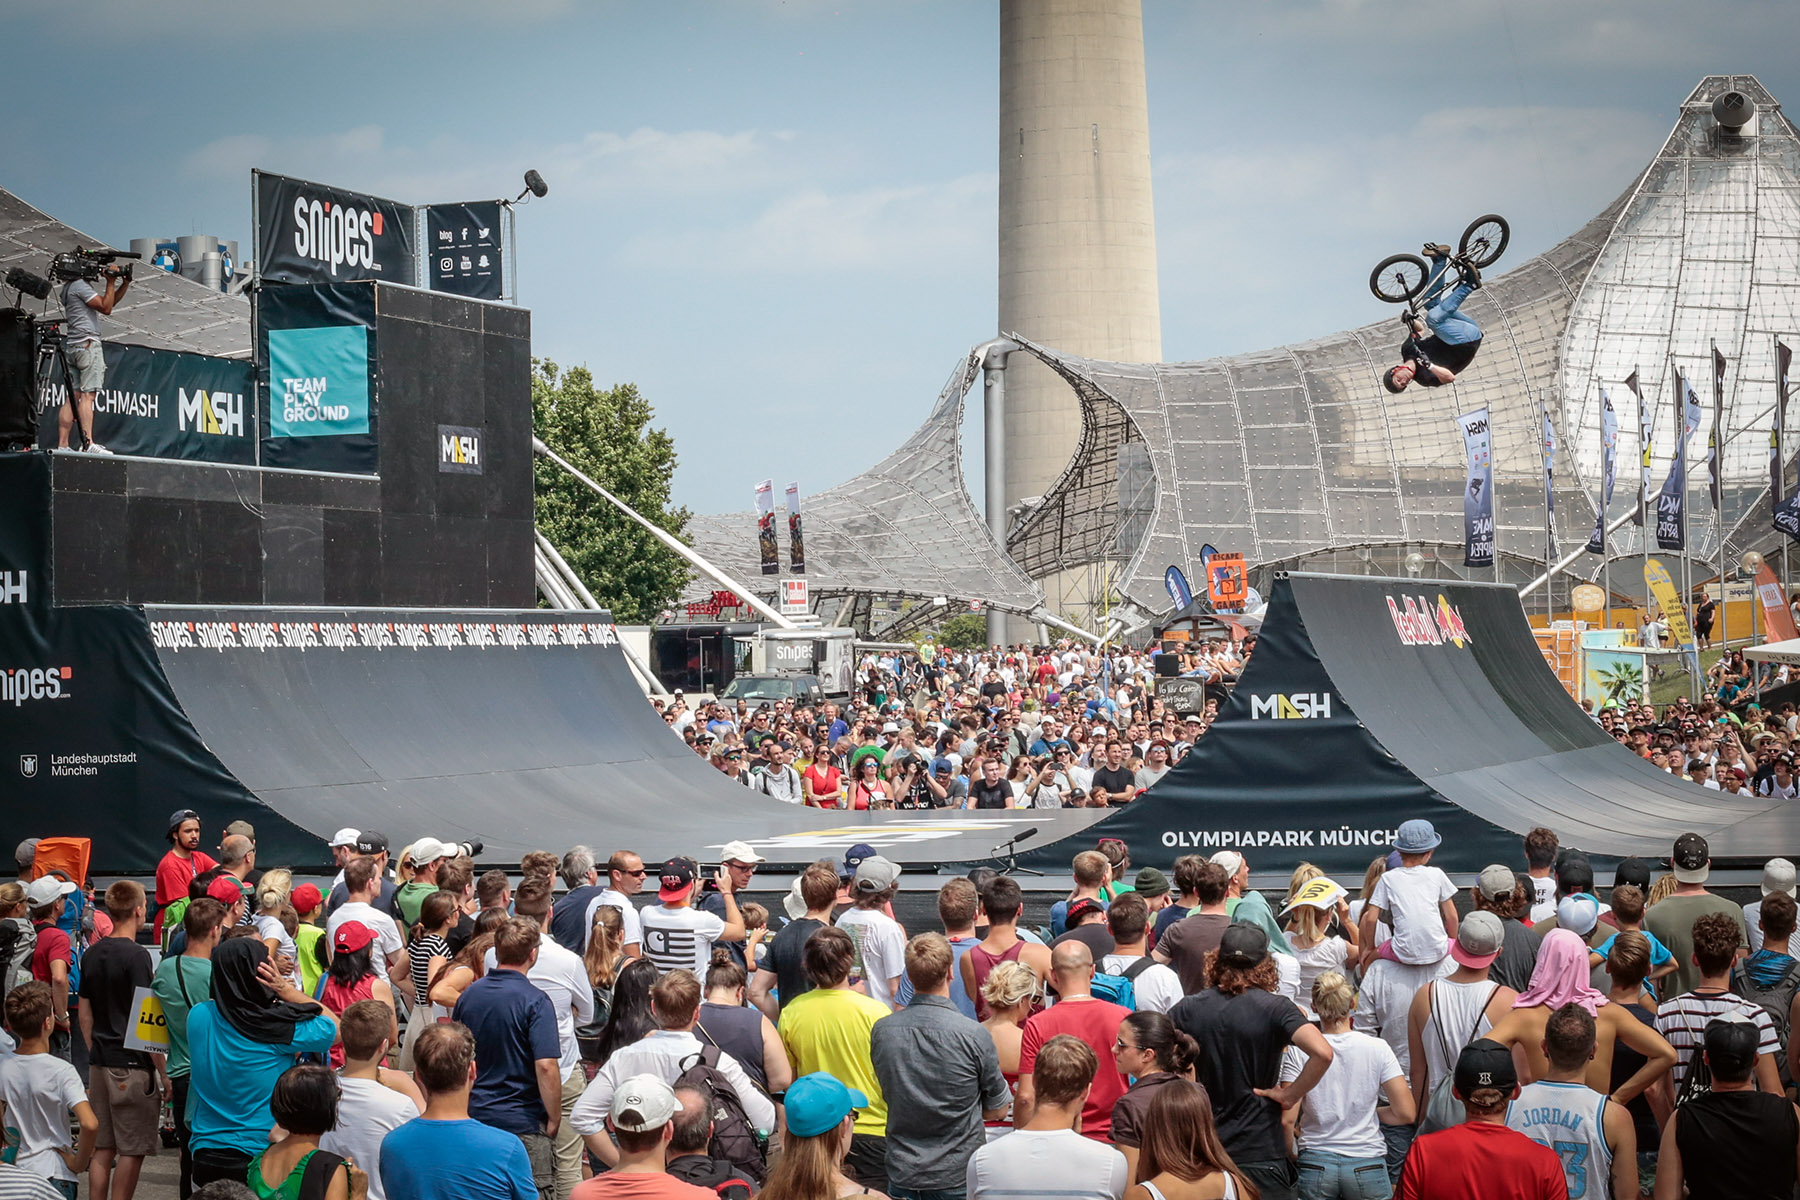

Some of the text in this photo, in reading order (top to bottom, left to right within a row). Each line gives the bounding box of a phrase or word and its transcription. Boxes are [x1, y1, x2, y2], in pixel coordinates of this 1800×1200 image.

[294, 196, 374, 276] snipes
[439, 230, 453, 243] blog
[283, 377, 327, 393] TEAM
[284, 392, 323, 408] PLAY
[178, 387, 244, 437] MASH
[283, 405, 349, 422] GROUND
[442, 434, 479, 465] MASH
[1217, 600, 1242, 609] GAME
[150, 621, 193, 652] snipes
[195, 622, 237, 652] snipes
[238, 622, 278, 652] snipes
[280, 622, 318, 652] snipes
[319, 622, 357, 651] snipes
[357, 622, 394, 651] snipes
[394, 623, 429, 651] snipes
[428, 623, 463, 651] snipes
[464, 623, 496, 650] snipes
[496, 623, 528, 650] snipes
[1251, 692, 1331, 719] MASH
[51, 752, 137, 766] Landeshauptstadt
[51, 765, 98, 776] München
[1161, 830, 1314, 848] OLYMPIAPARK
[1523, 1107, 1584, 1132] JORDAN
